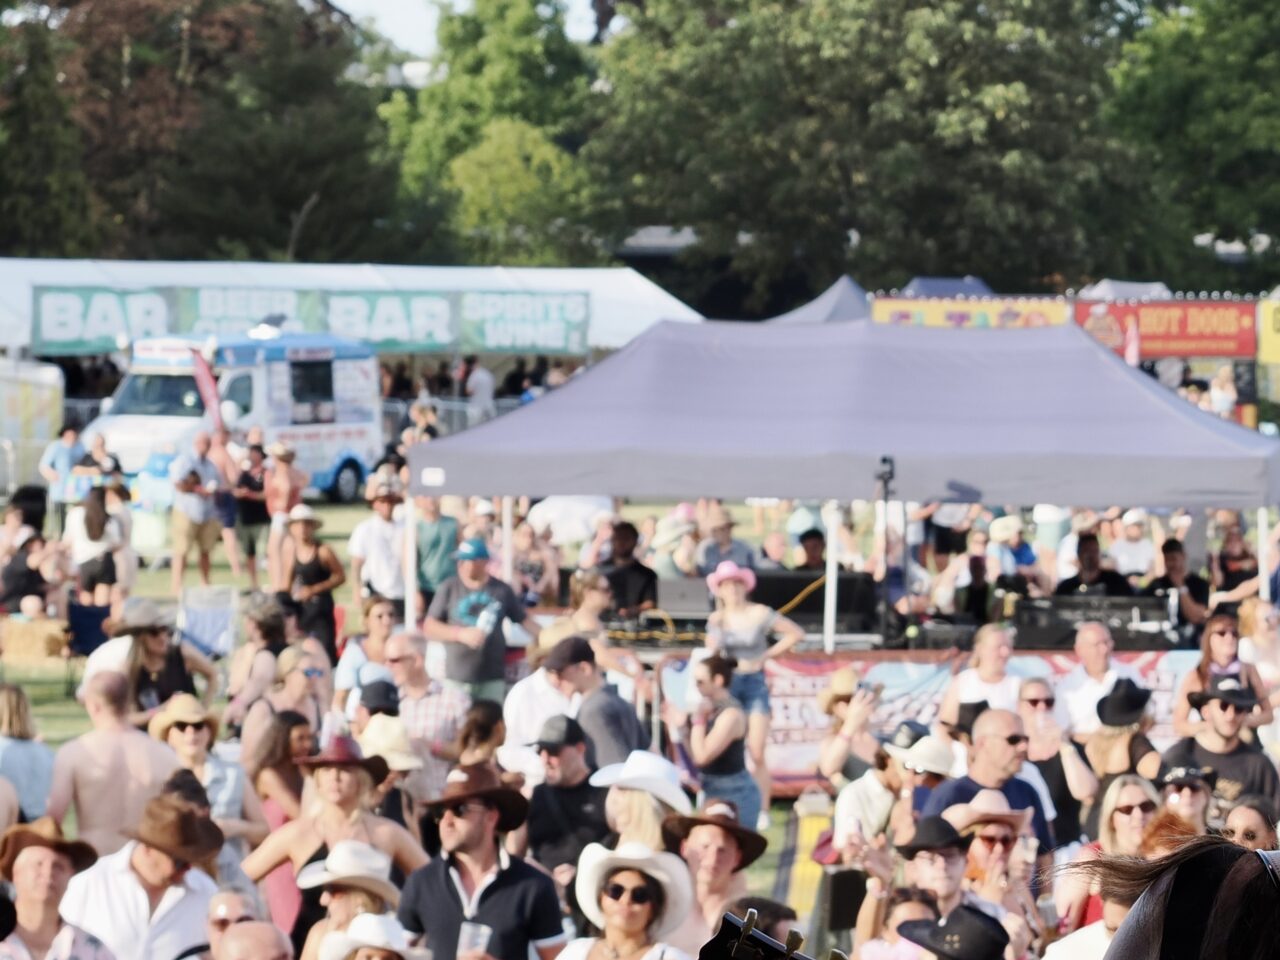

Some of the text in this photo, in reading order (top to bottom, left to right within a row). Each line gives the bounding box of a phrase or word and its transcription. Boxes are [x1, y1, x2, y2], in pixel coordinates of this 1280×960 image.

[40, 292, 171, 342] BAR
[328, 295, 450, 343] BAR
[461, 293, 586, 320] SPIRITS
[1138, 307, 1240, 336] HOT DOGS
